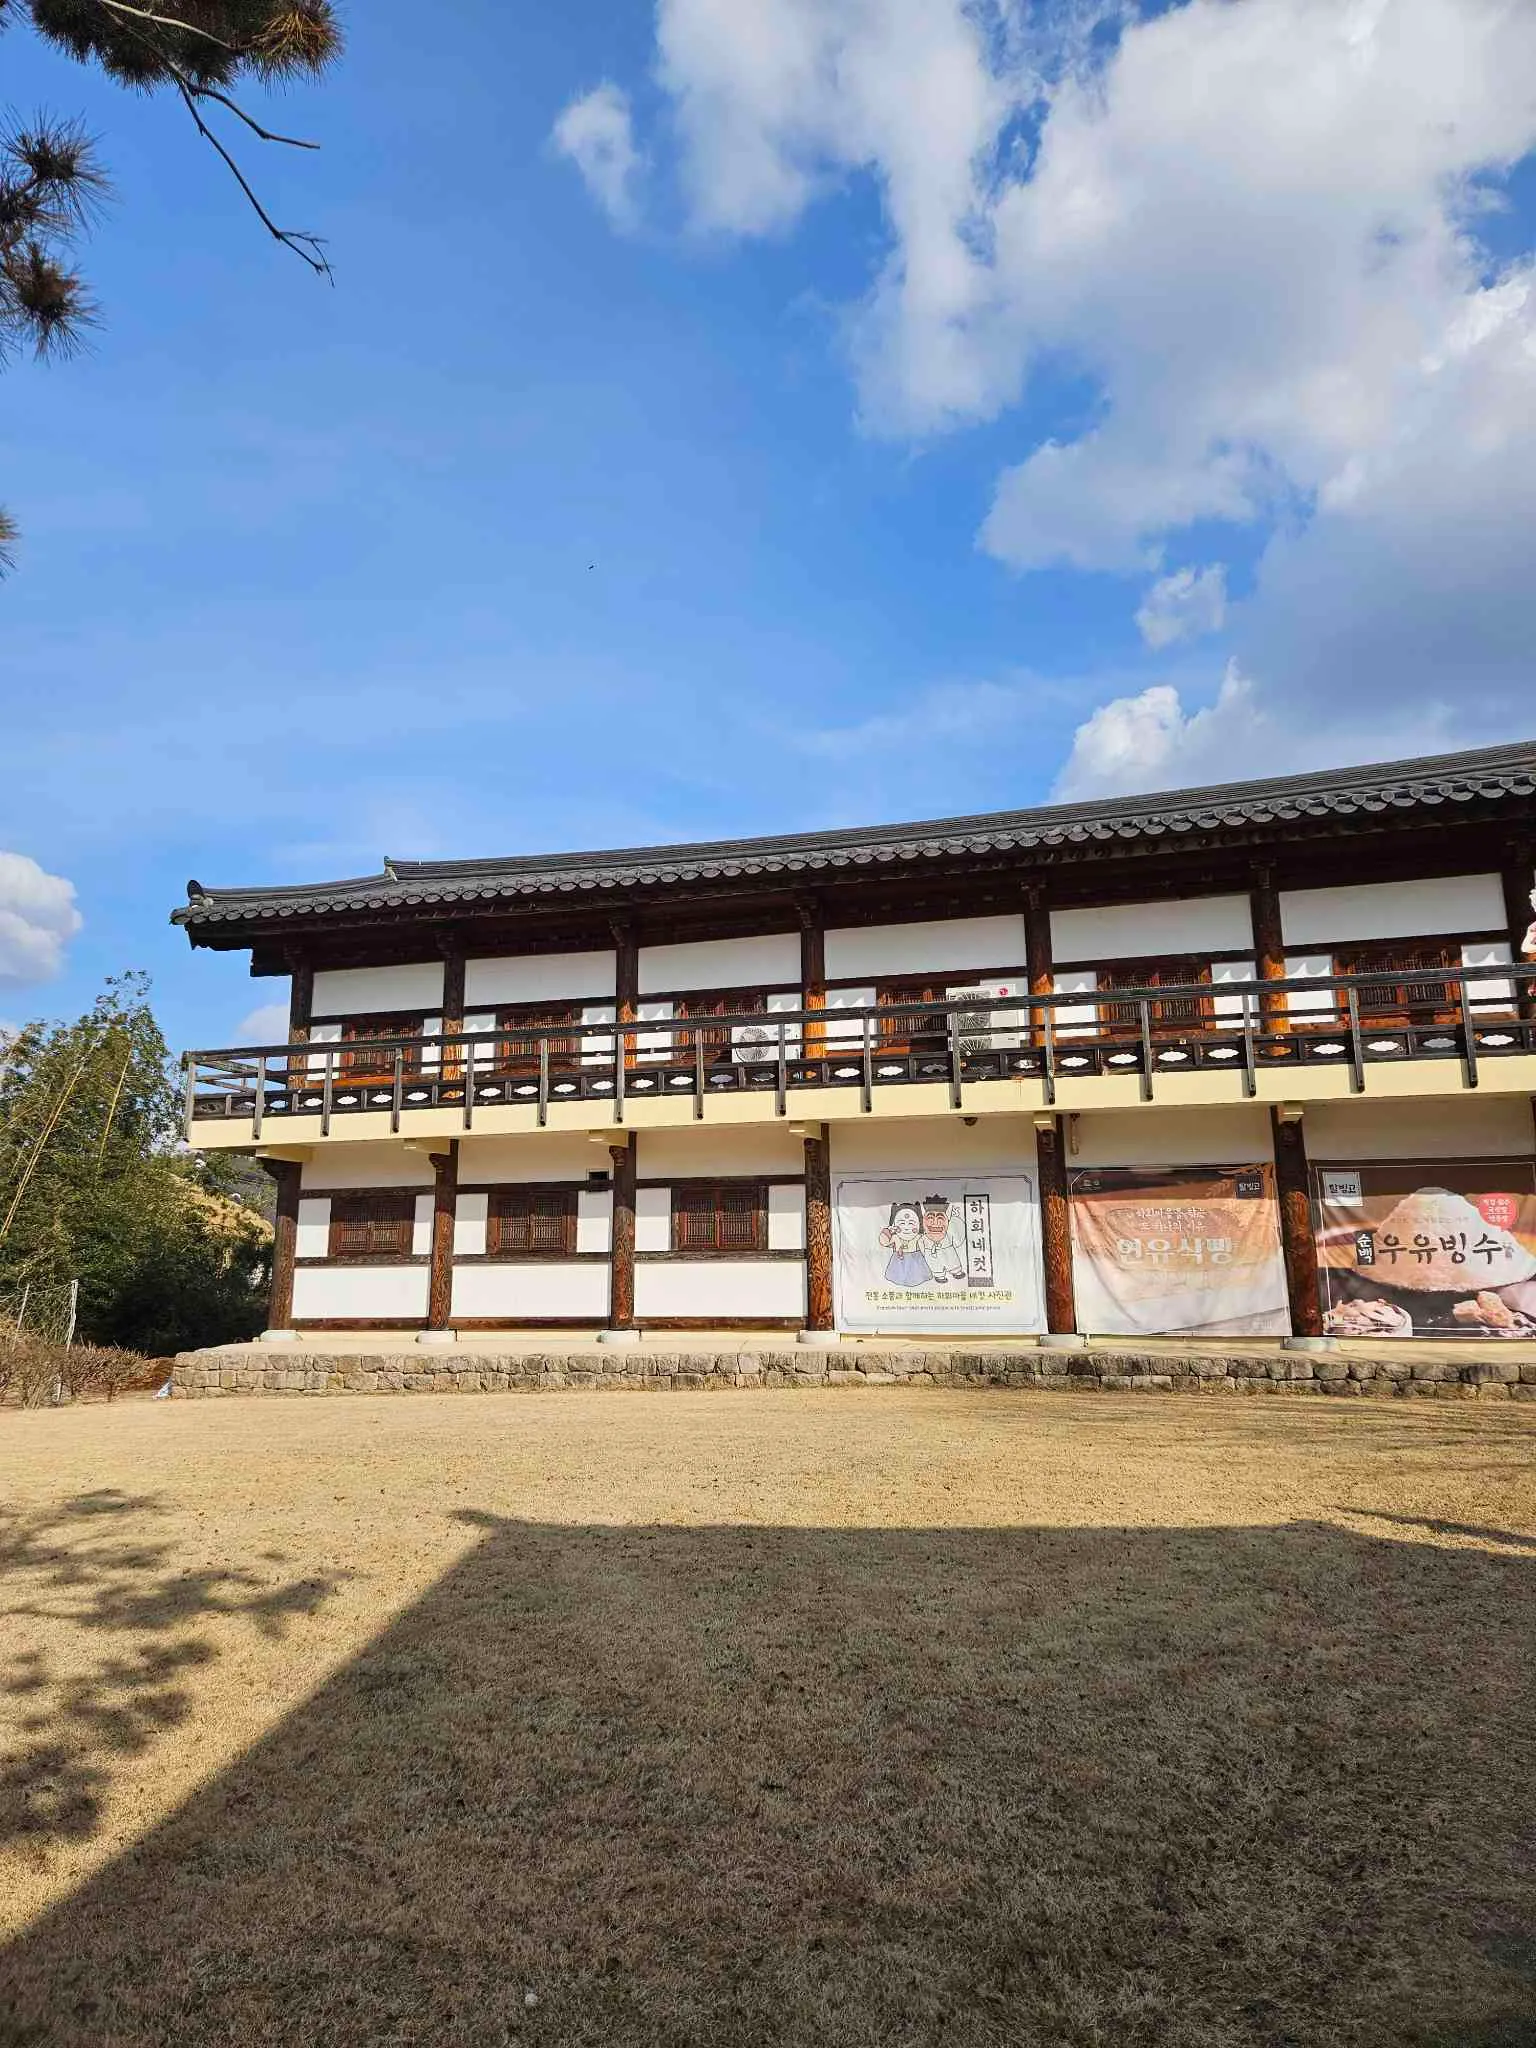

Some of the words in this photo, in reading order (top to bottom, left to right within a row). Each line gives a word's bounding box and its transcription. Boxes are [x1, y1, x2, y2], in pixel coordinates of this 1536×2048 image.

[969, 1199, 987, 1272] 하회네컷
[1117, 1237, 1233, 1265] 연유식빵
[1358, 1233, 1373, 1264] 순백
[1378, 1232, 1503, 1265] 우유빙수
[905, 1289, 935, 1301] 함께하는
